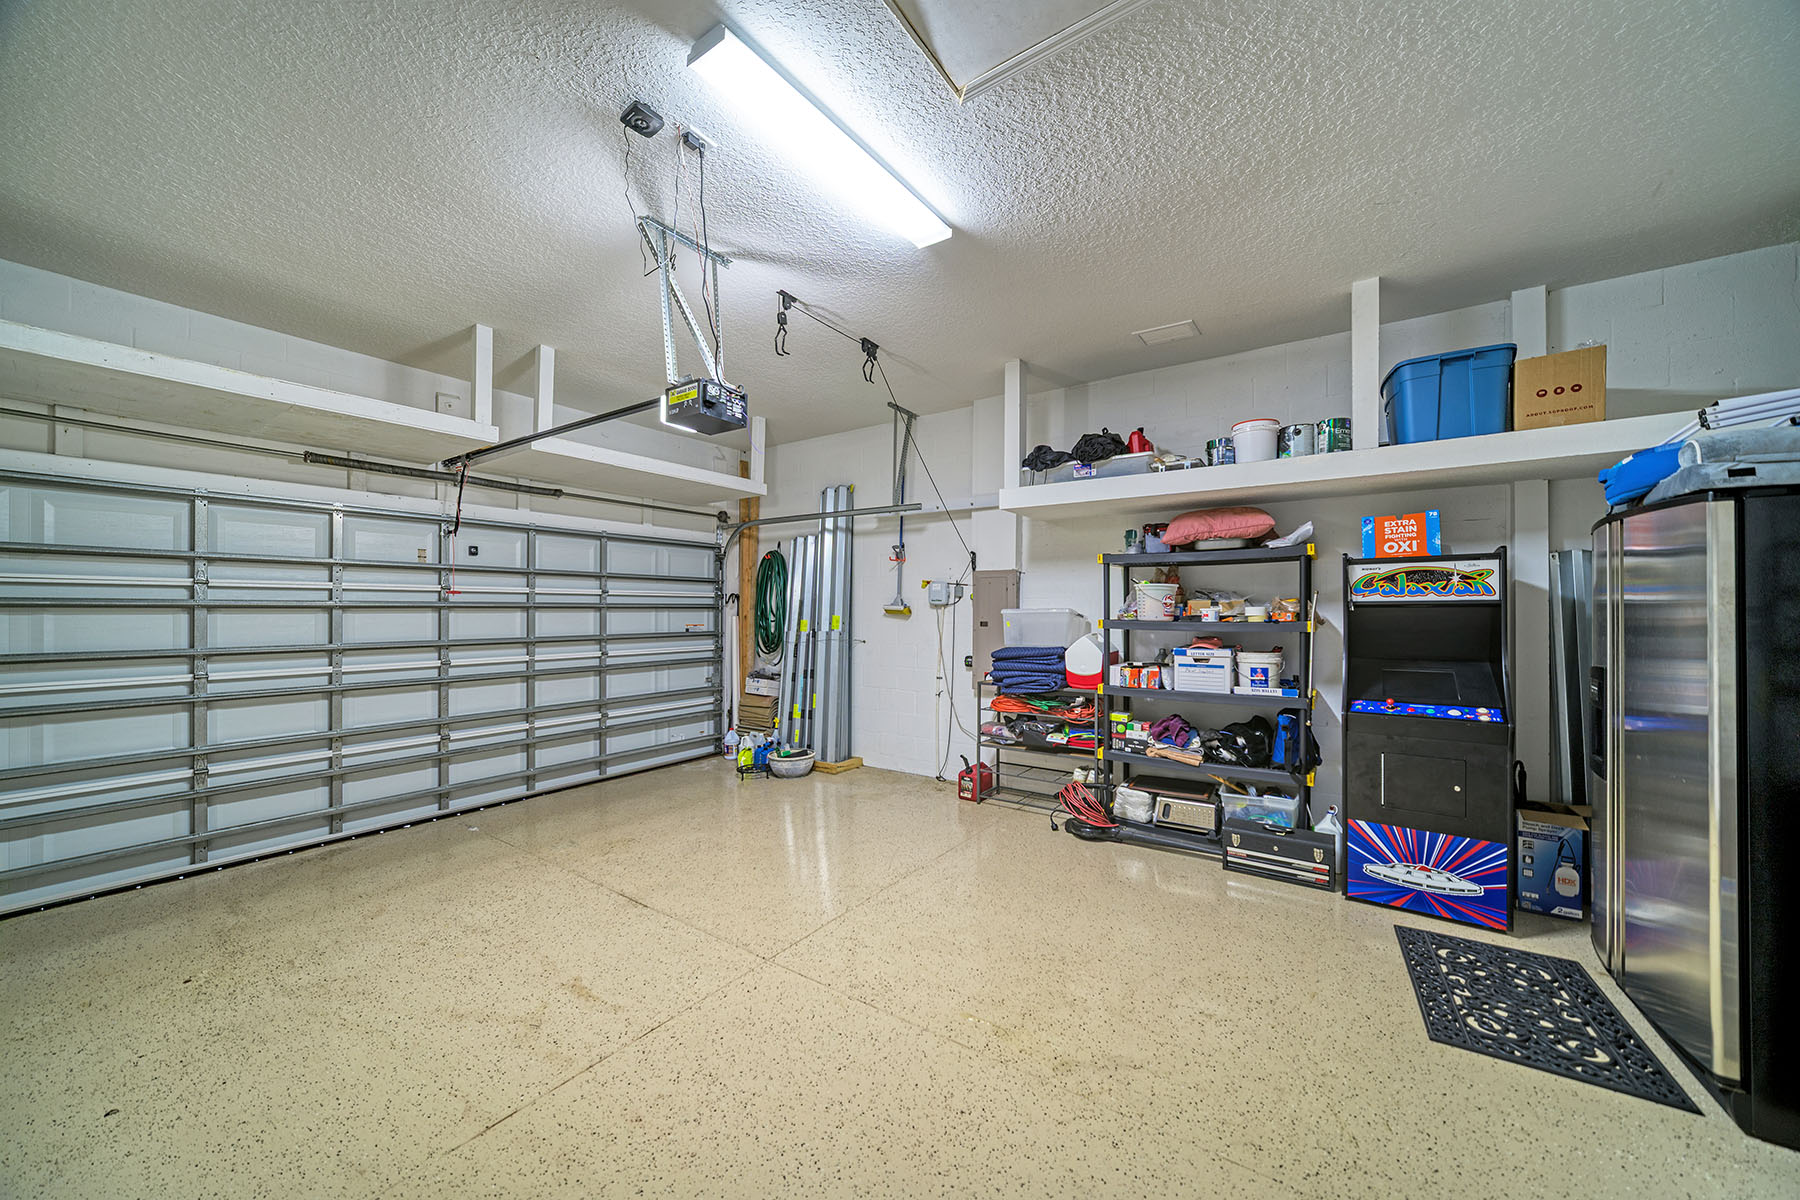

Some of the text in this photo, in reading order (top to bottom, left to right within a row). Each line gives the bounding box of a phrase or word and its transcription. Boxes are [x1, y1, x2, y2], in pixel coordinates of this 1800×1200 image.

[1384, 519, 1416, 527] EXTRA
[1384, 525, 1417, 535] STAIN
[1384, 540, 1417, 553] OXI
[1351, 566, 1497, 598] Galaxian
